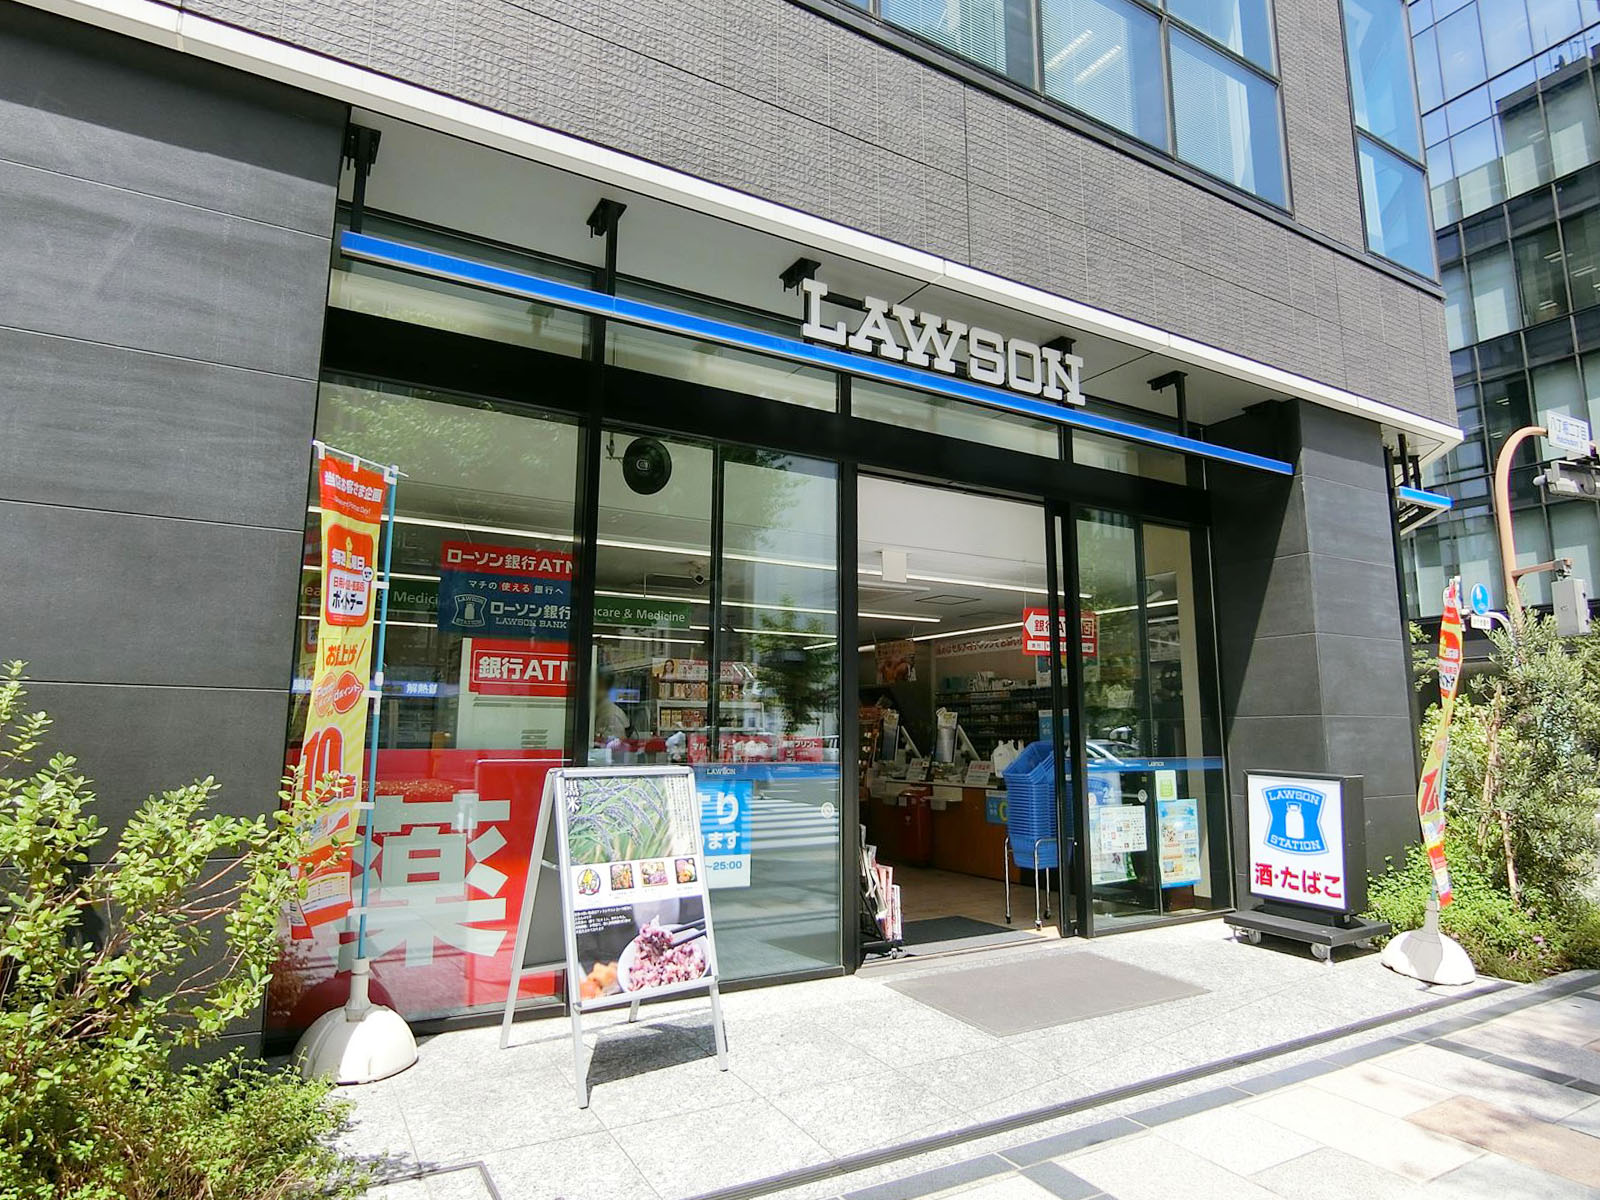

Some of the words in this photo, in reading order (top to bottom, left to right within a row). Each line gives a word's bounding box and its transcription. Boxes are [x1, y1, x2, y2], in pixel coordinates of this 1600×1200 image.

[803, 278, 1086, 406] LAWSON
[468, 579, 497, 590] マチの
[501, 581, 530, 593] 使える
[534, 584, 564, 595] 銀行へ
[490, 601, 571, 620] ローソン銀行
[623, 608, 633, 618] &
[636, 609, 685, 622] Medicine
[495, 616, 537, 627] LAWSON
[538, 620, 568, 629] BANK
[1267, 789, 1321, 806] LAWSON
[1269, 833, 1321, 851] STATION
[1254, 862, 1343, 899] 酒・たばこ
